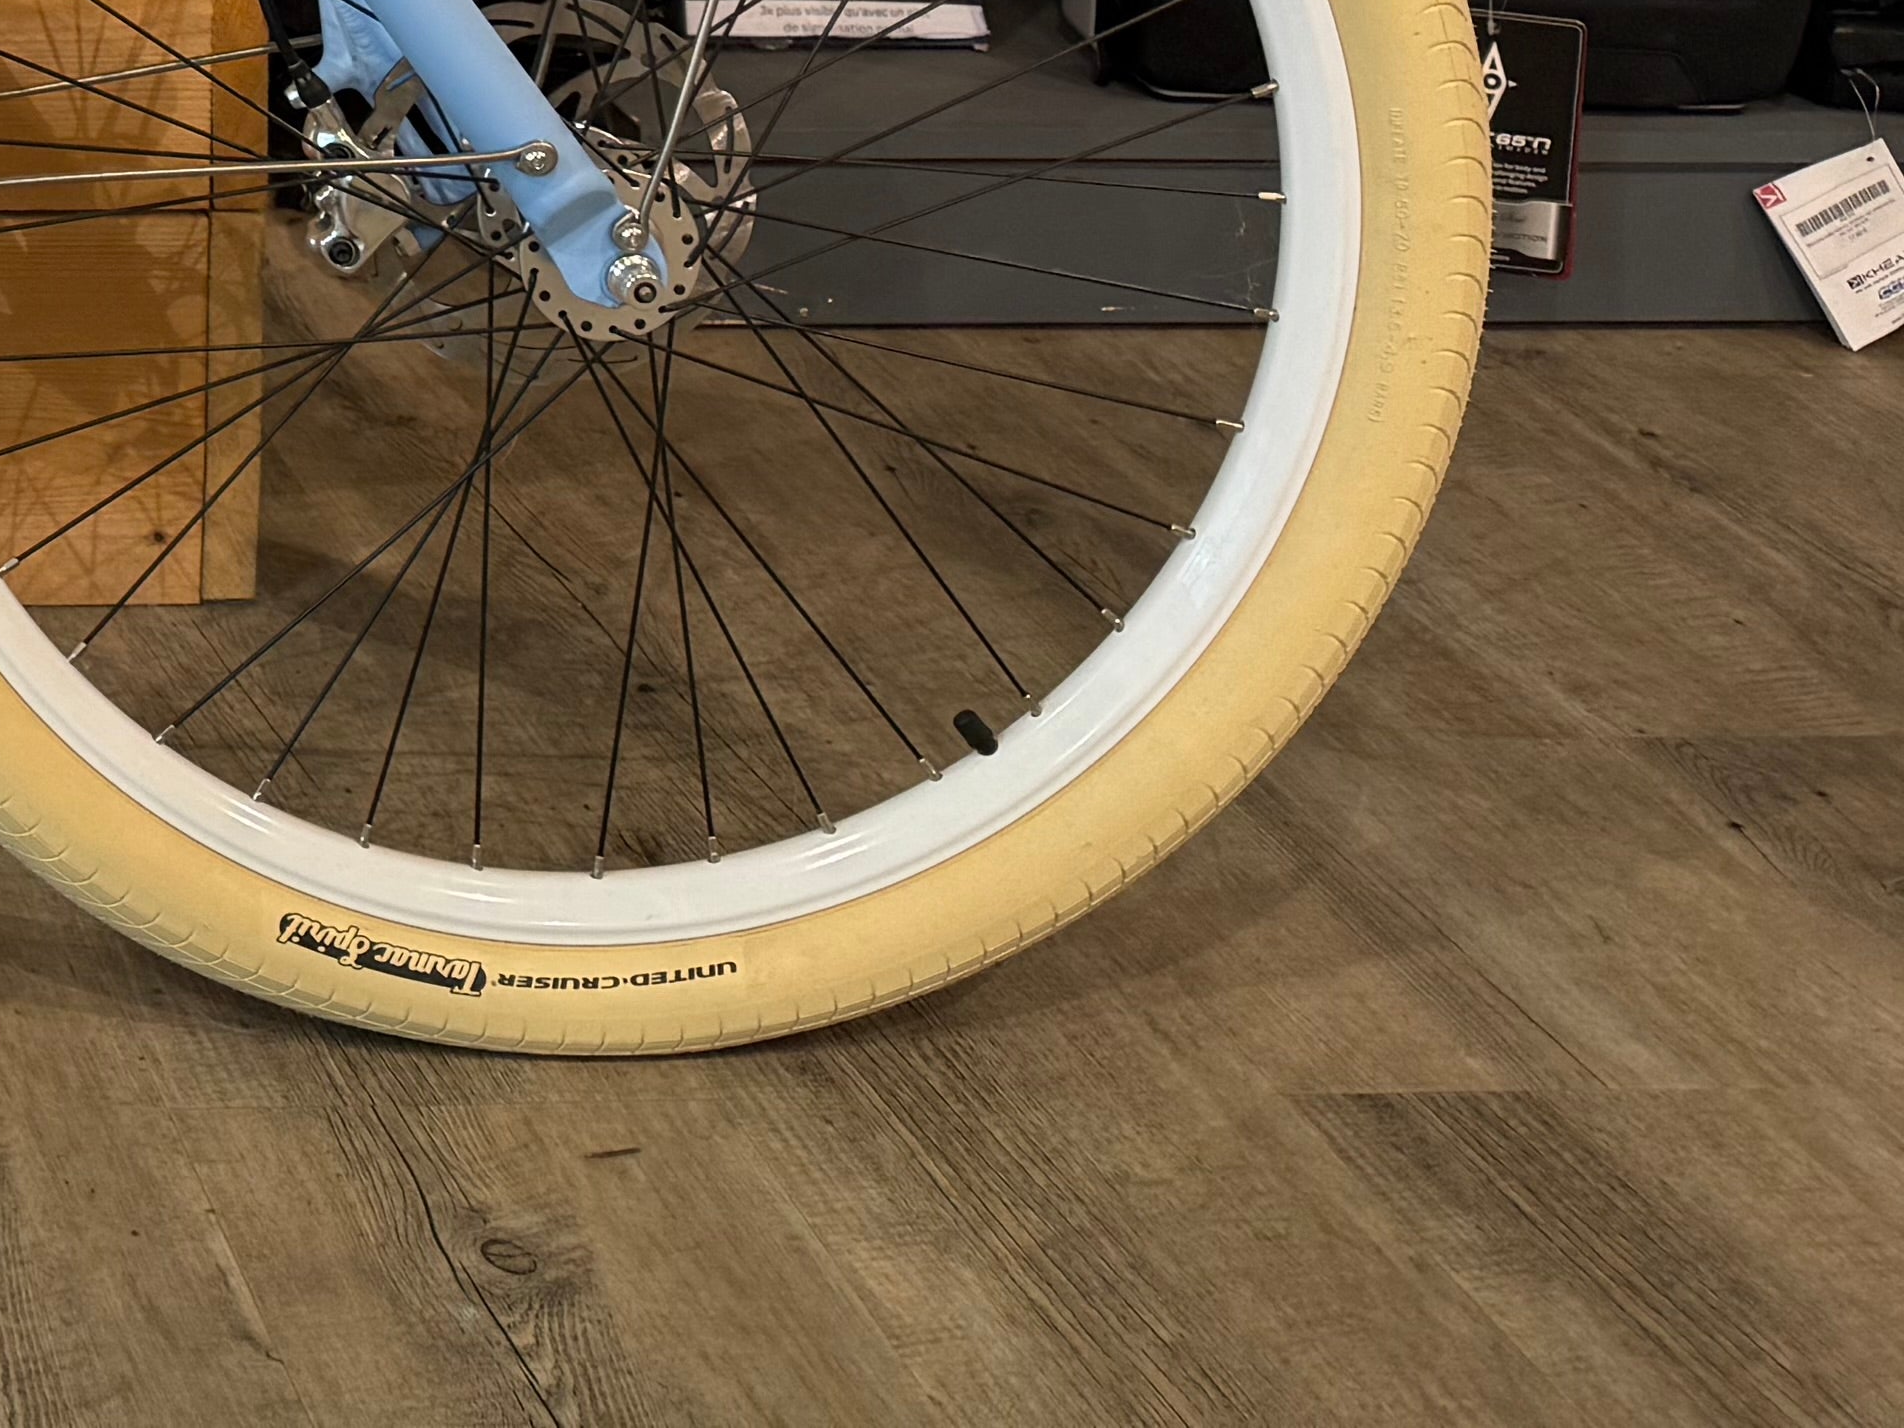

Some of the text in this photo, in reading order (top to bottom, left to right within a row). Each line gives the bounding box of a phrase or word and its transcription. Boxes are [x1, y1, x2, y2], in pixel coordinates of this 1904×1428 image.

[776, 6, 802, 17] plus
[276, 911, 486, 998] Tarmac Spirit
